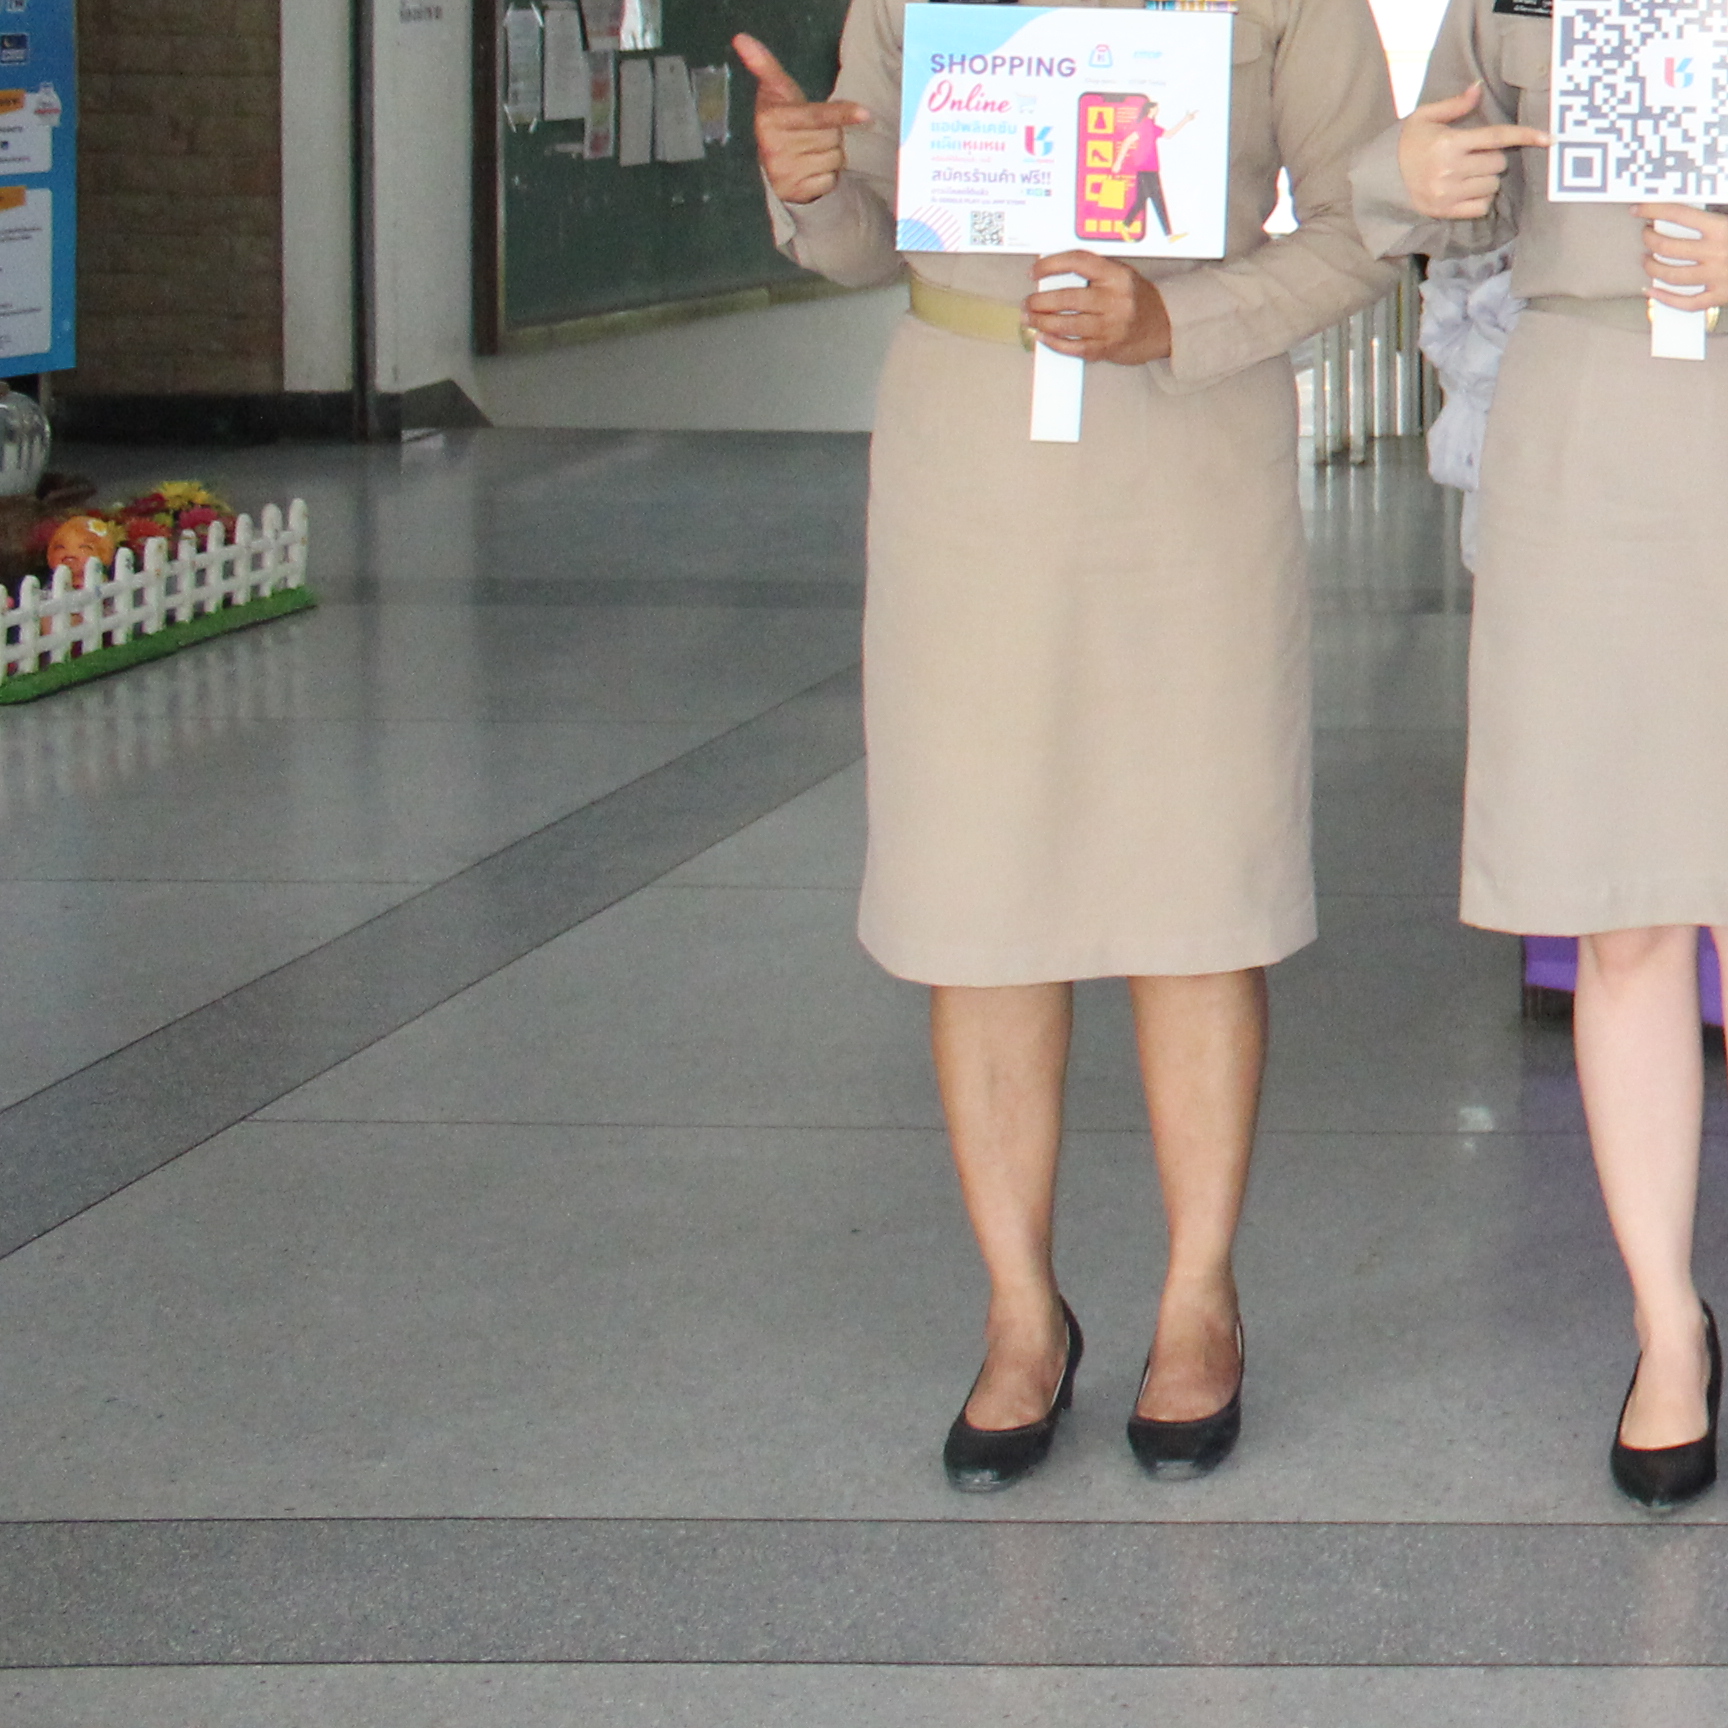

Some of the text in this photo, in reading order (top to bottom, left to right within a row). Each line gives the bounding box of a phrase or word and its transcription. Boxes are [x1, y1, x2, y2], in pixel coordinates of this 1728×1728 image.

[930, 53, 1077, 77] SHOPPING
[927, 79, 1012, 113] Online
[932, 166, 1051, 185] สมัครร้านค้า ฟรี!!
